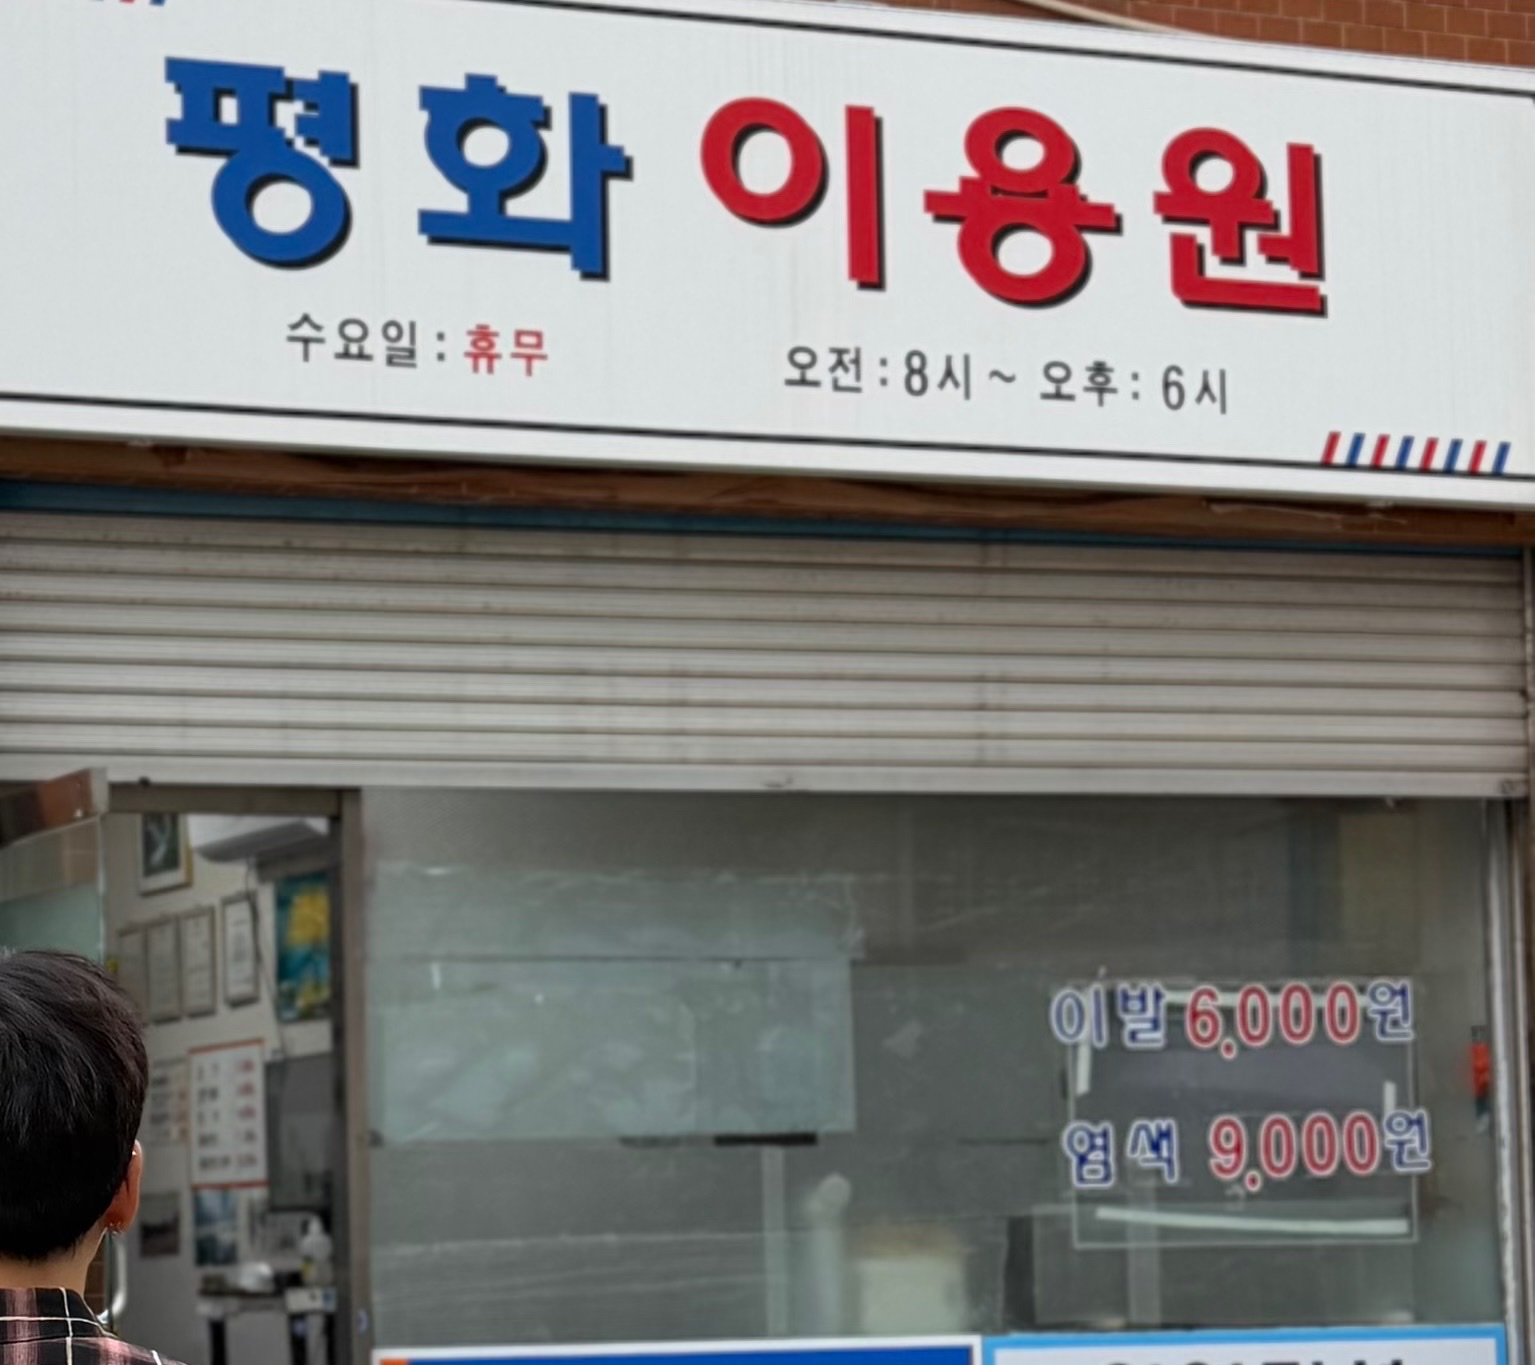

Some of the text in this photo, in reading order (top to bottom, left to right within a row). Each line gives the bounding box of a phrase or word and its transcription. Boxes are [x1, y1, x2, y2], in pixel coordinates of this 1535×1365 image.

[164, 55, 1328, 318] 평화 이용원
[1051, 982, 1165, 1049] 이발
[1063, 1120, 1179, 1187] 염색
